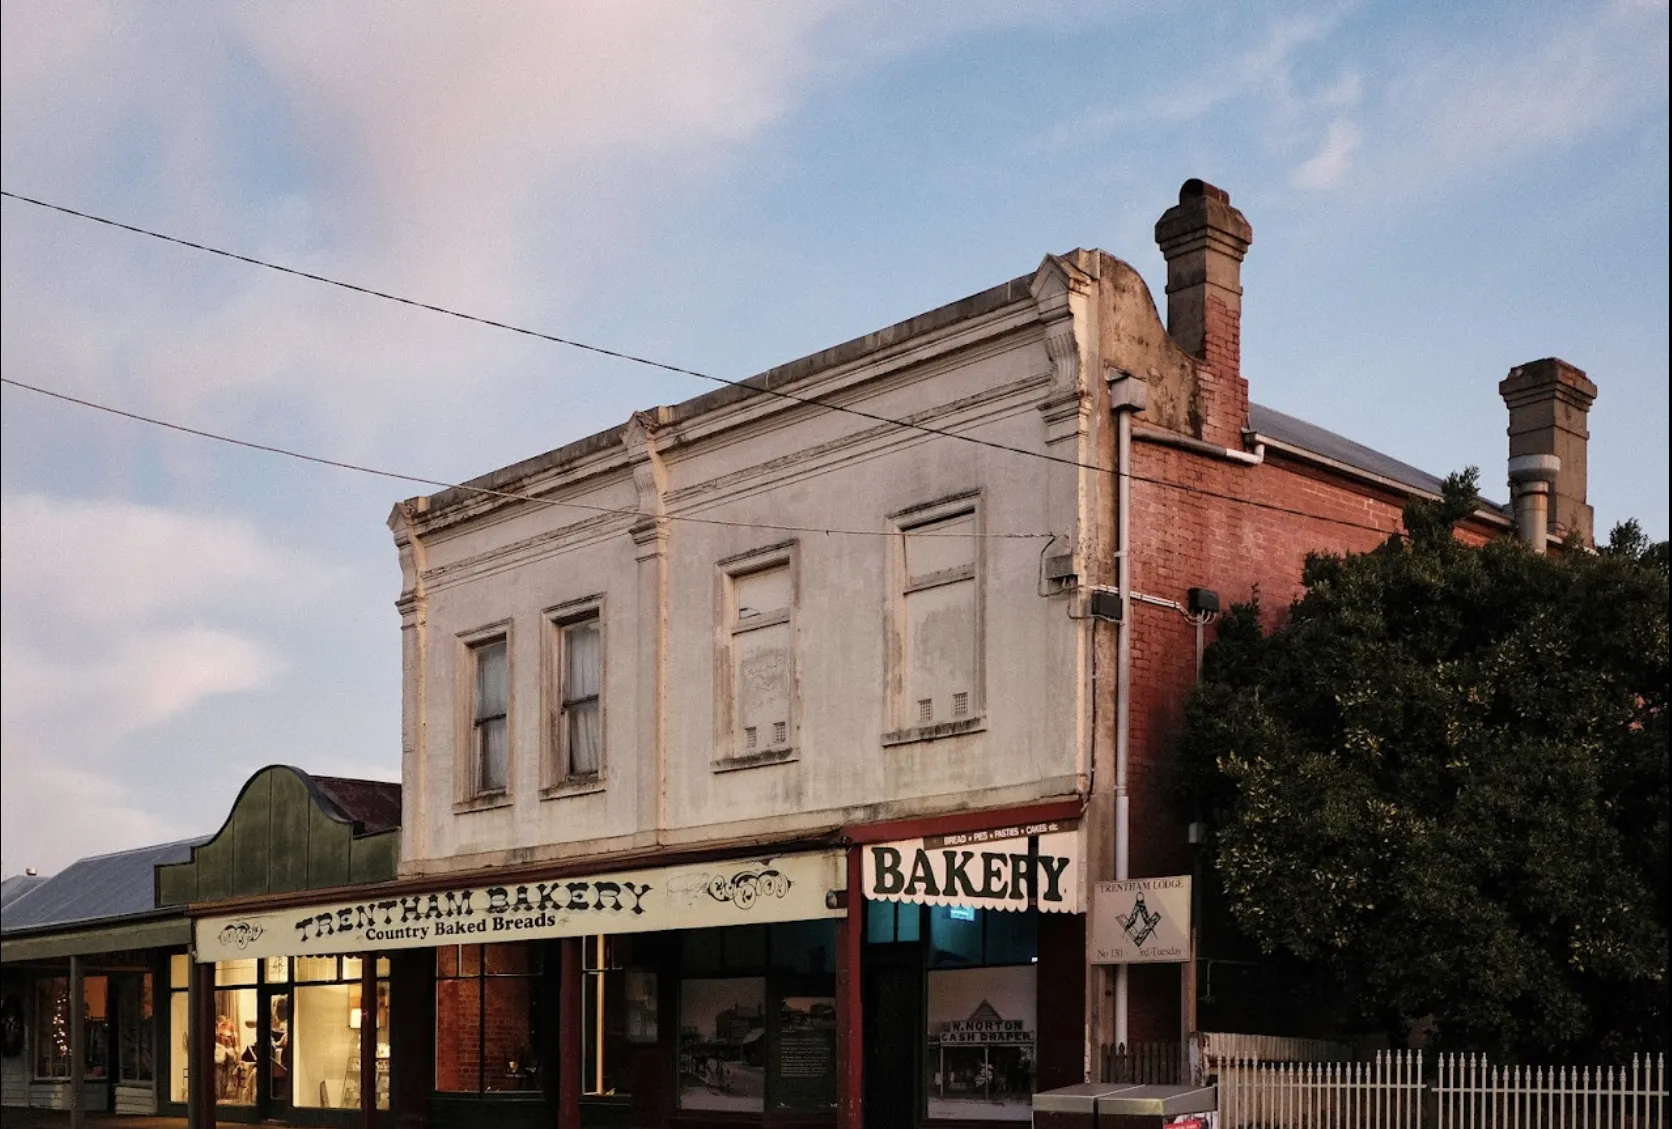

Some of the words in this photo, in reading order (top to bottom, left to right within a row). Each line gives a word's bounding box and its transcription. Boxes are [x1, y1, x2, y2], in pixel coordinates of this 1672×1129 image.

[944, 835, 966, 846] BREAD
[974, 831, 988, 842] PIES
[994, 827, 1019, 839] PASTIES
[1026, 823, 1047, 834] CAKES
[871, 847, 1070, 902] BAKERY
[1099, 880, 1151, 893] TRENTHAM
[1152, 879, 1184, 890] LODGE
[295, 889, 474, 942] TRENTHAM
[485, 881, 653, 915] BAKERY
[366, 926, 430, 940] Country
[434, 920, 487, 936] Baked
[492, 913, 556, 931] Breads
[941, 1032, 975, 1042] CASH
[980, 1032, 1031, 1041] DRAPER
